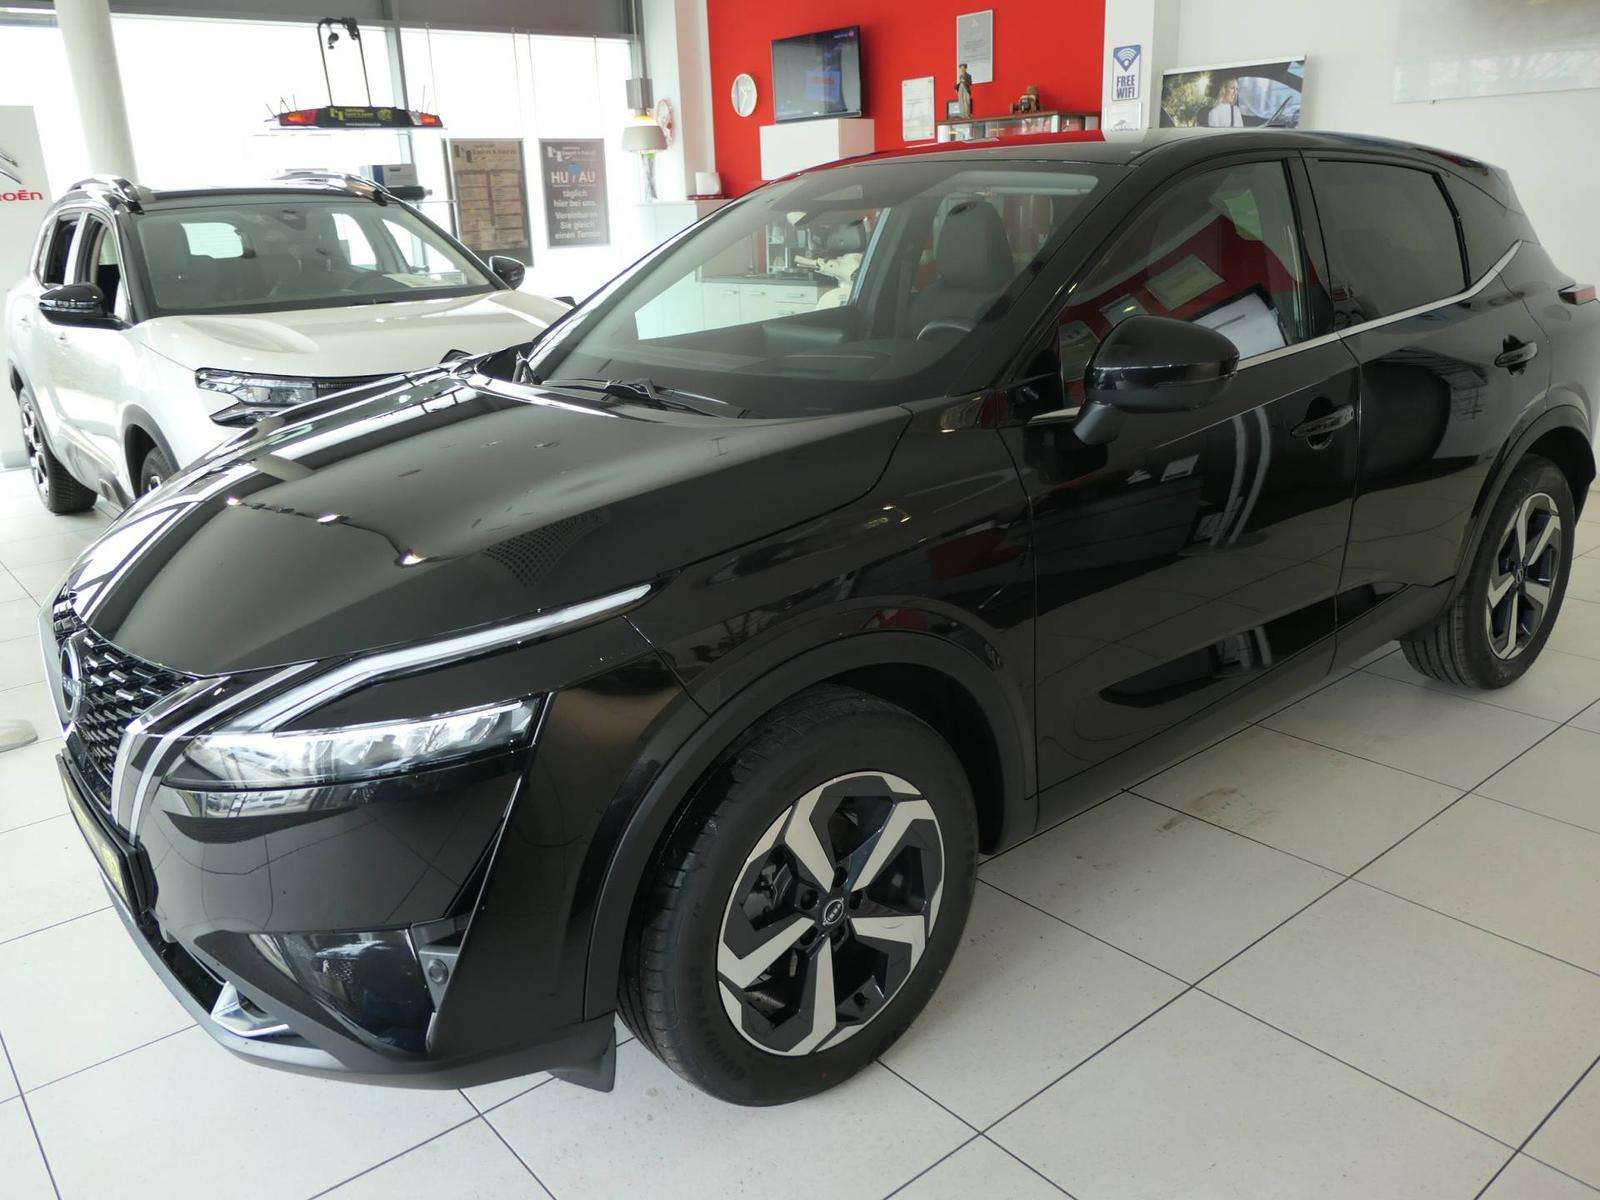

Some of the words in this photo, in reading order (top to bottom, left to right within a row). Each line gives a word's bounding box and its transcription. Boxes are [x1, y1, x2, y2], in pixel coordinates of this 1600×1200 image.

[1117, 75, 1135, 86] FREE
[1117, 87, 1135, 98] WIFI
[551, 171, 569, 184] HU
[579, 171, 596, 183] AU
[553, 200, 569, 208] hier
[569, 200, 582, 208] bei
